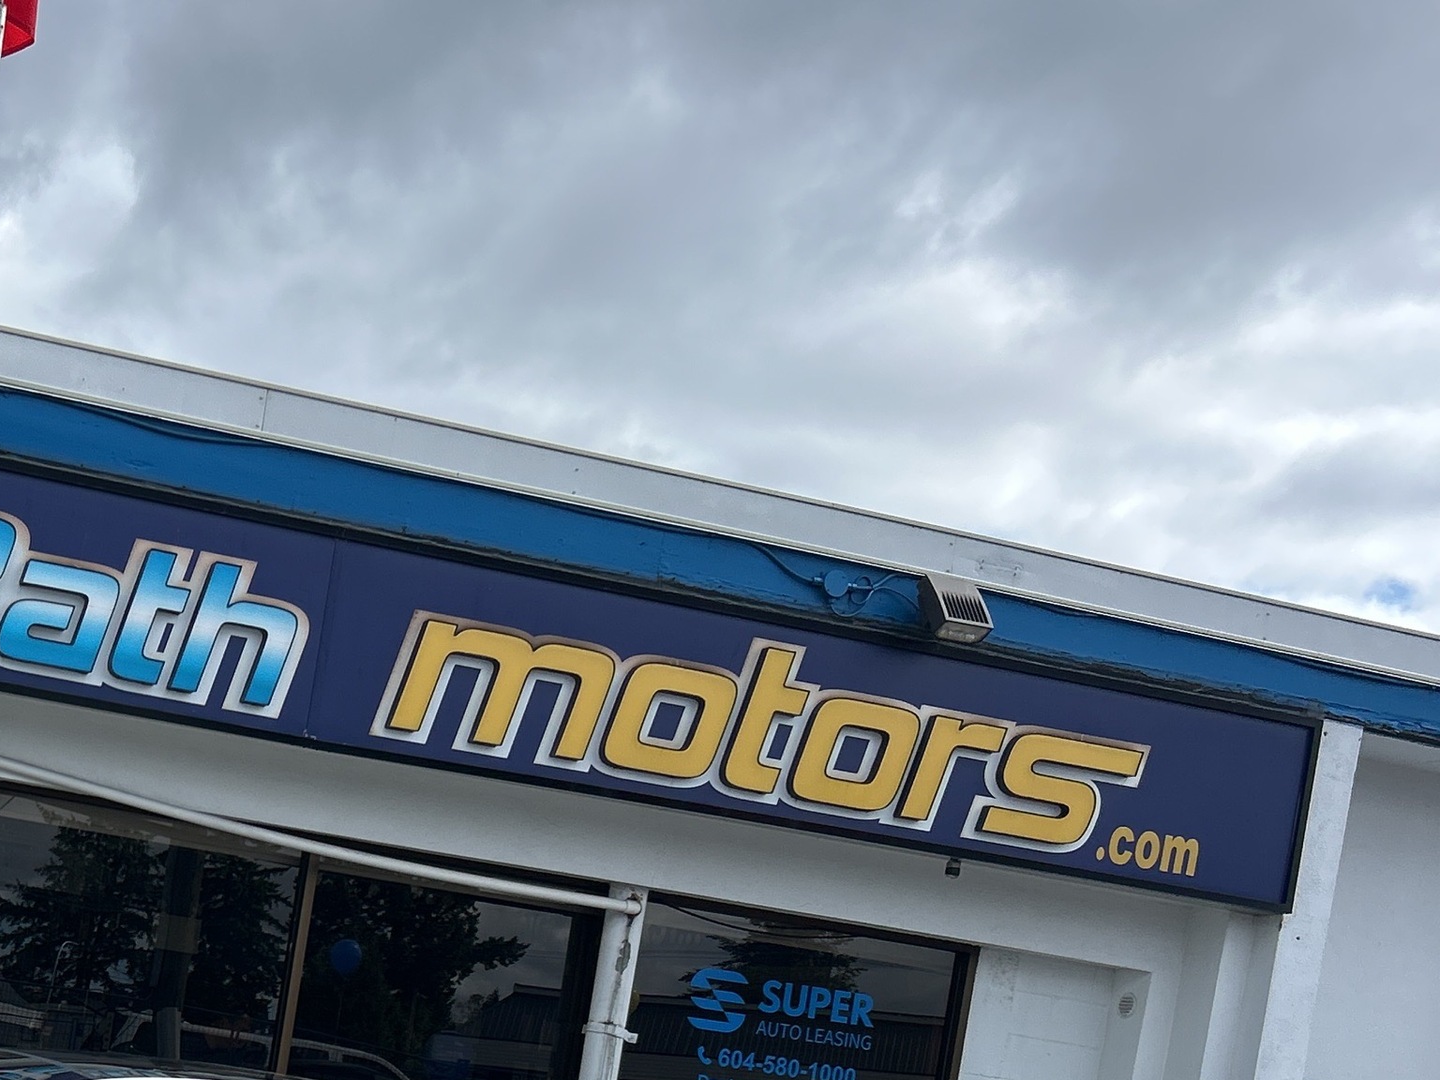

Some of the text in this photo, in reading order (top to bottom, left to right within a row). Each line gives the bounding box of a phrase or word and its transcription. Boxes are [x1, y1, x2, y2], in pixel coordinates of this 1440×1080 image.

[369, 609, 1152, 854] motors
[1094, 824, 1200, 877] .com
[758, 980, 874, 1028] SUPER
[756, 1021, 873, 1051] AUTO LEASING
